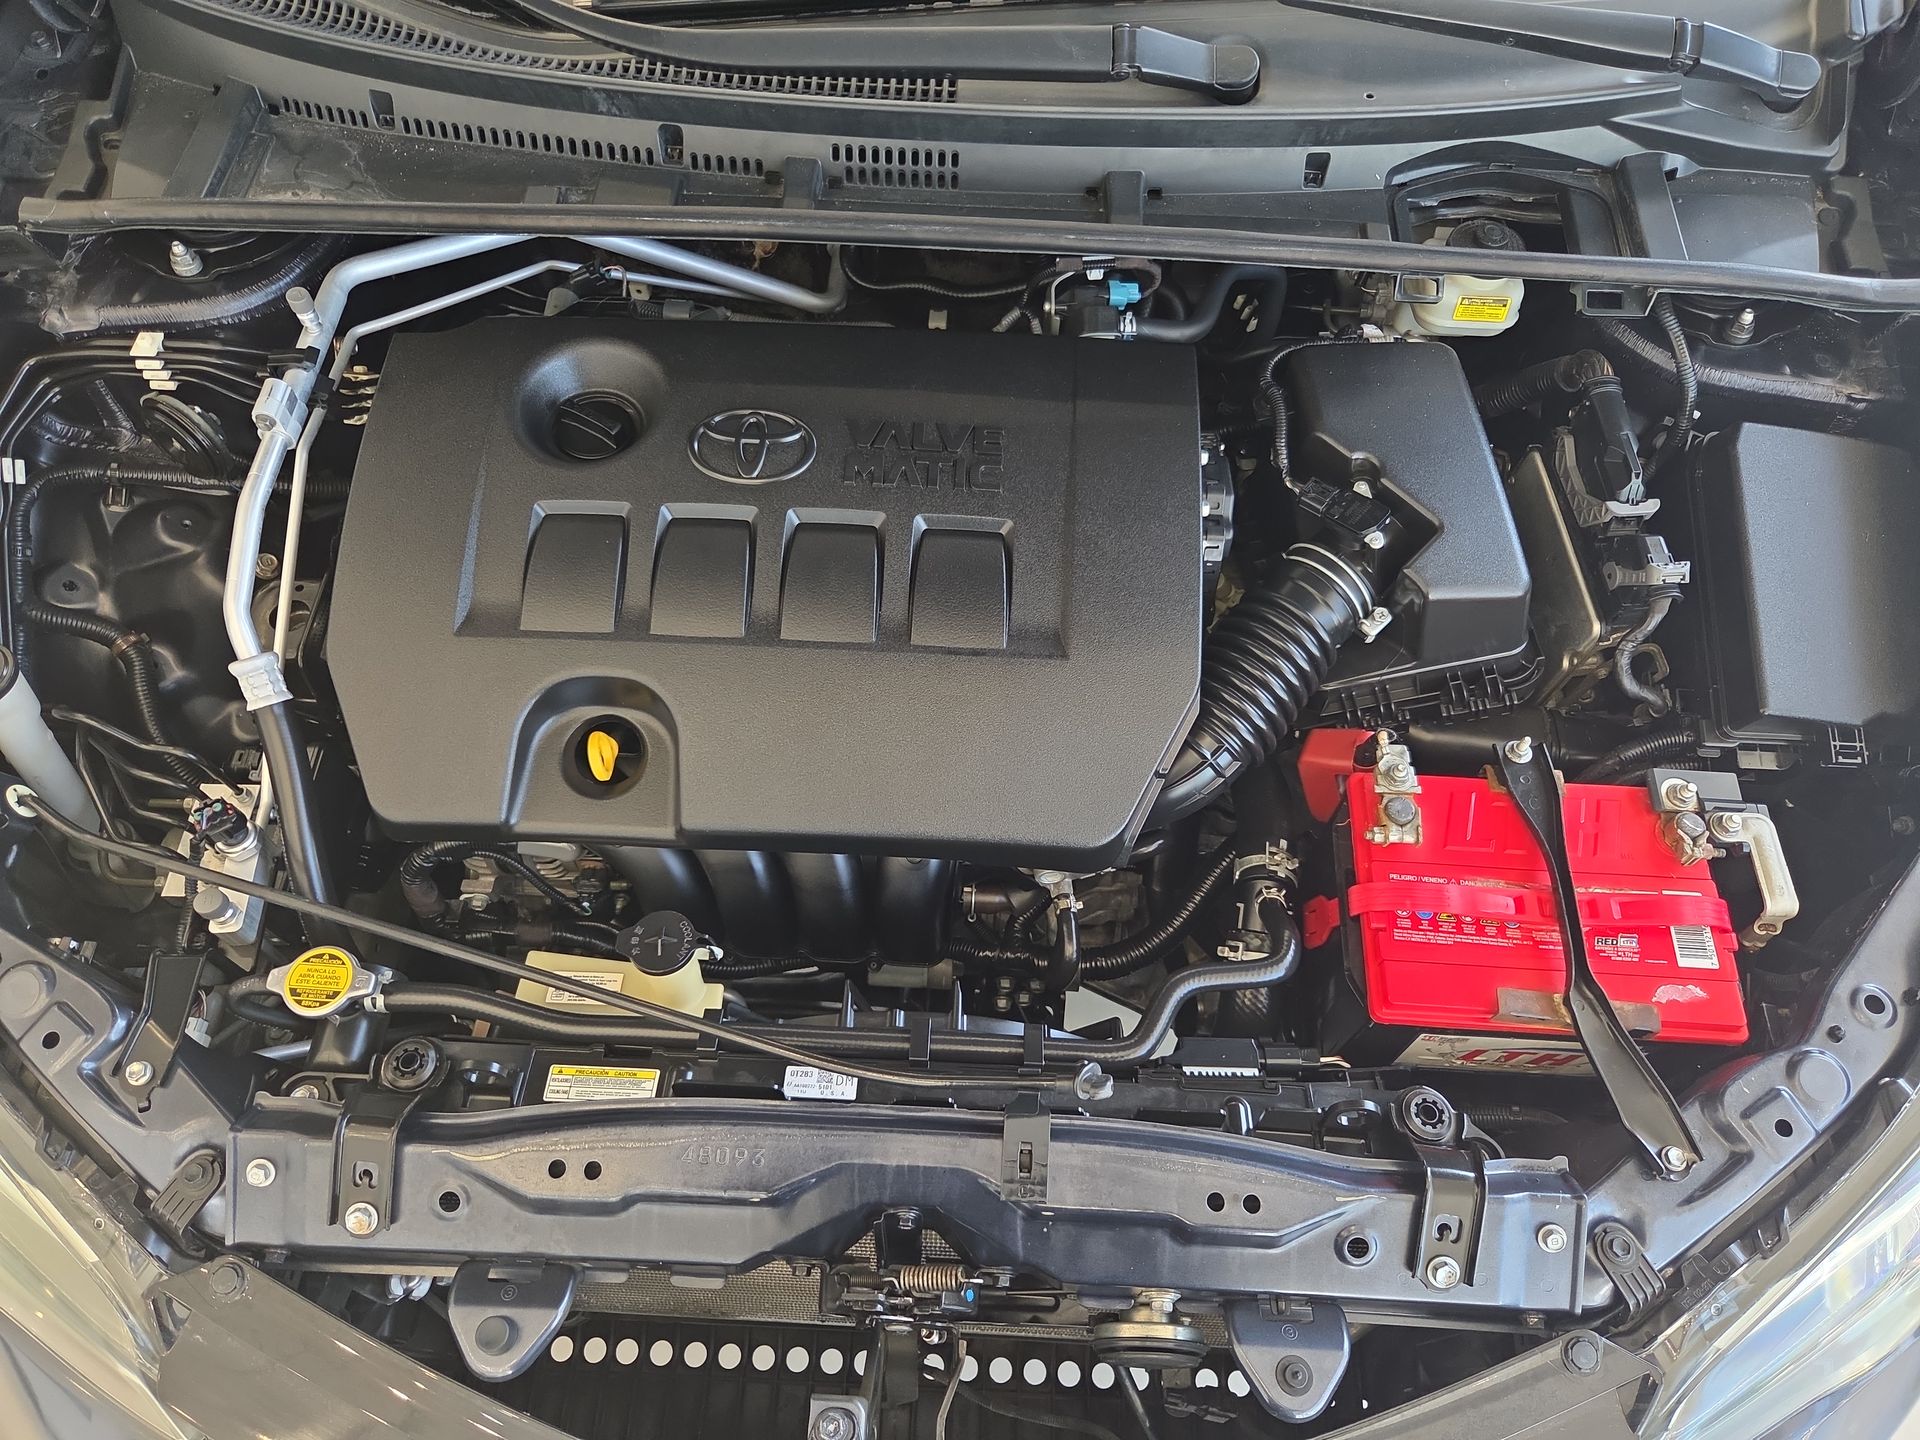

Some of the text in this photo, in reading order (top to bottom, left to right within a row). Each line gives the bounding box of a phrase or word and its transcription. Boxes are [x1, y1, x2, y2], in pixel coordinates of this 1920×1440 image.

[849, 419, 1004, 454] VALVE
[843, 455, 1004, 493] MATIC
[1389, 873, 1417, 881] PELIGRO
[1420, 876, 1448, 884] VENENO
[678, 920, 693, 959] COOLANT
[1596, 937, 1618, 946] RED
[1455, 1048, 1586, 1067] LTH
[835, 1075, 854, 1087] DM
[681, 1145, 766, 1167] 48093
